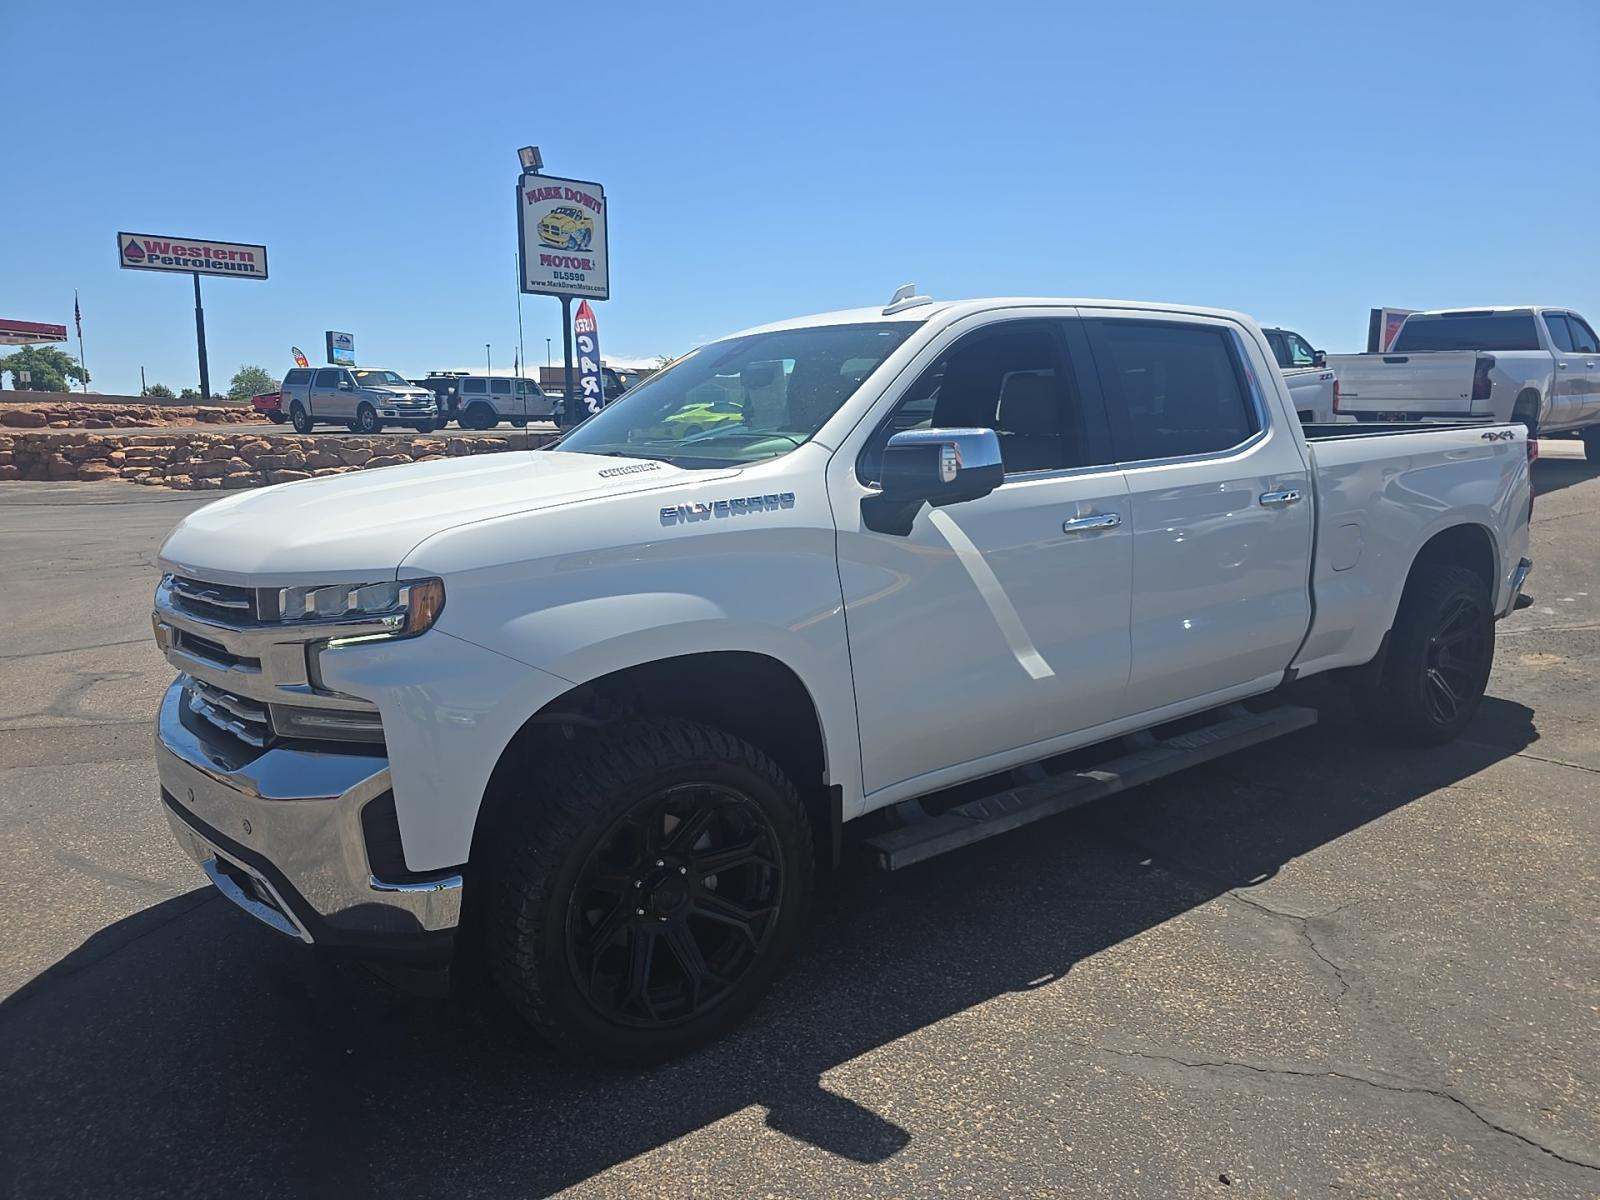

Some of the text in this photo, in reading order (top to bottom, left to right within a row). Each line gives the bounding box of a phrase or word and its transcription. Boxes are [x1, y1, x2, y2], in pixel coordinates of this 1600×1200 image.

[526, 186, 603, 214] MARK DOWN
[143, 240, 254, 262] Western
[540, 253, 592, 271] MOTOR
[147, 253, 256, 272] Petroleum
[660, 491, 796, 527] SILVERADO
